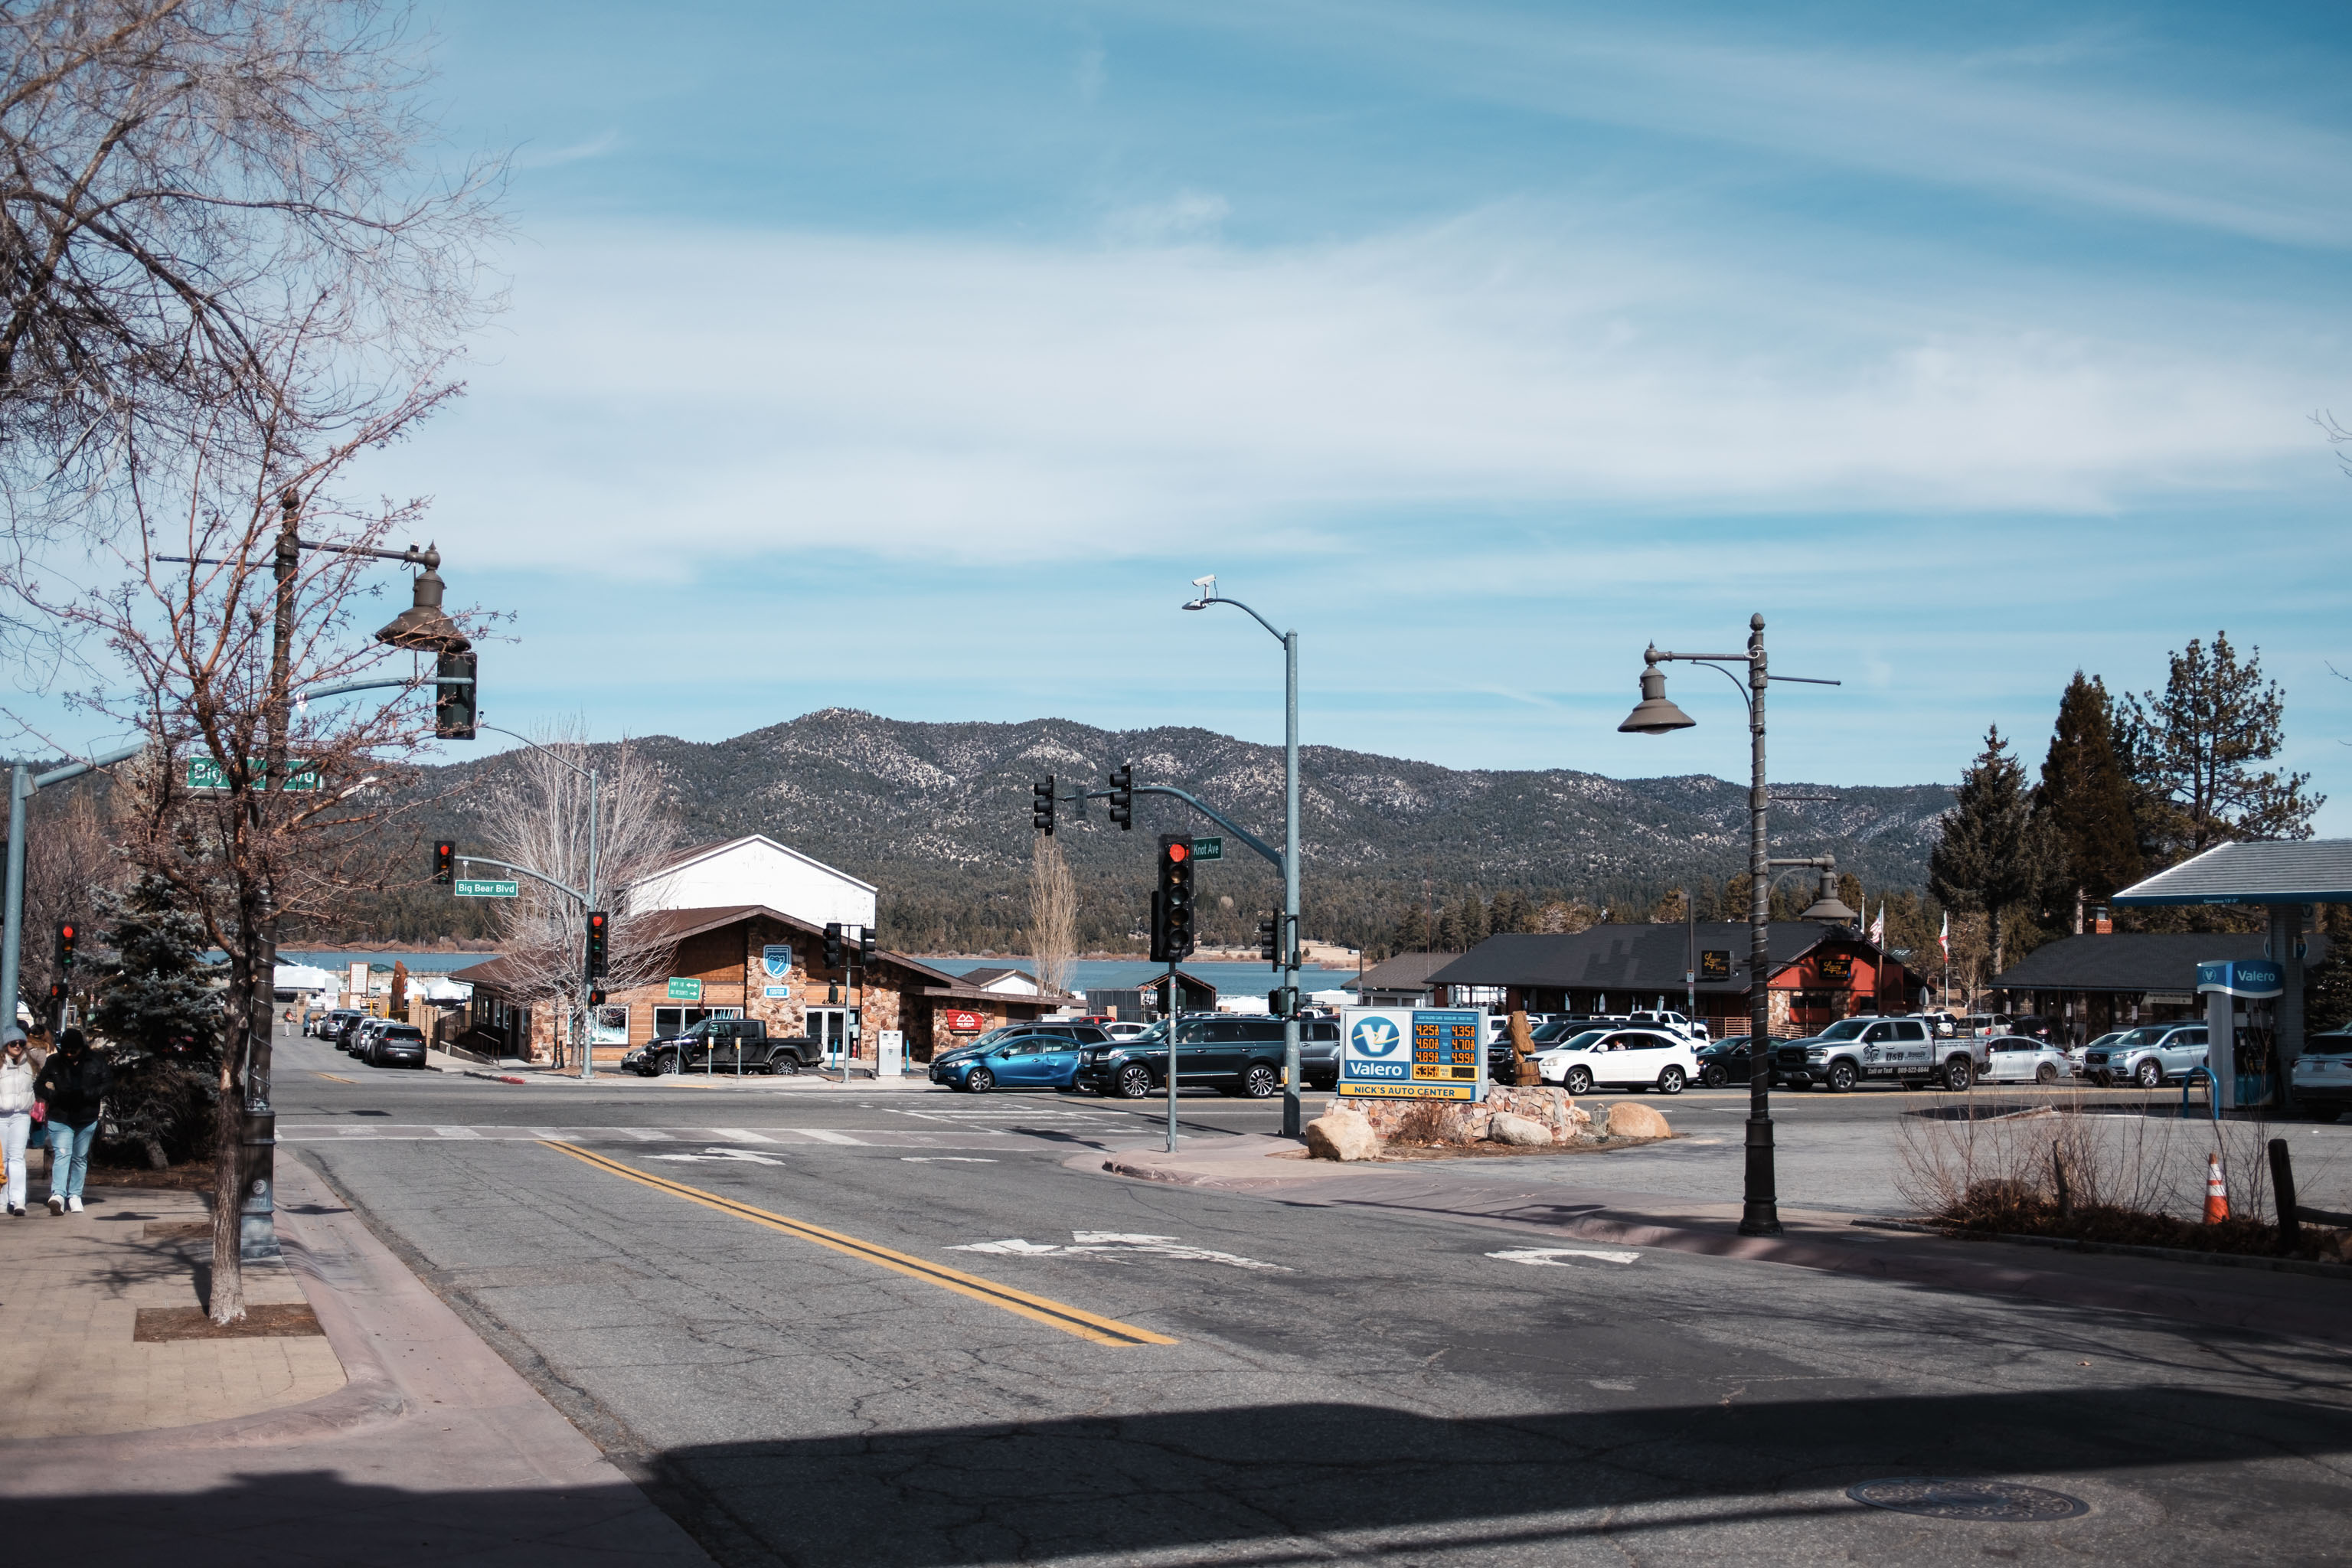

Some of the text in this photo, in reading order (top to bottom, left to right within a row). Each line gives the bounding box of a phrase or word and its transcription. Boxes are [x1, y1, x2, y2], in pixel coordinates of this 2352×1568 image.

[194, 763, 223, 784] Big
[1194, 843, 1219, 855] Knot Ave
[459, 884, 514, 893] Big Bear Blvd
[2237, 970, 2275, 982] Valero
[1350, 1062, 1403, 1076] Valero
[1354, 1086, 1455, 1096] NICK'S AUTO CENTER
